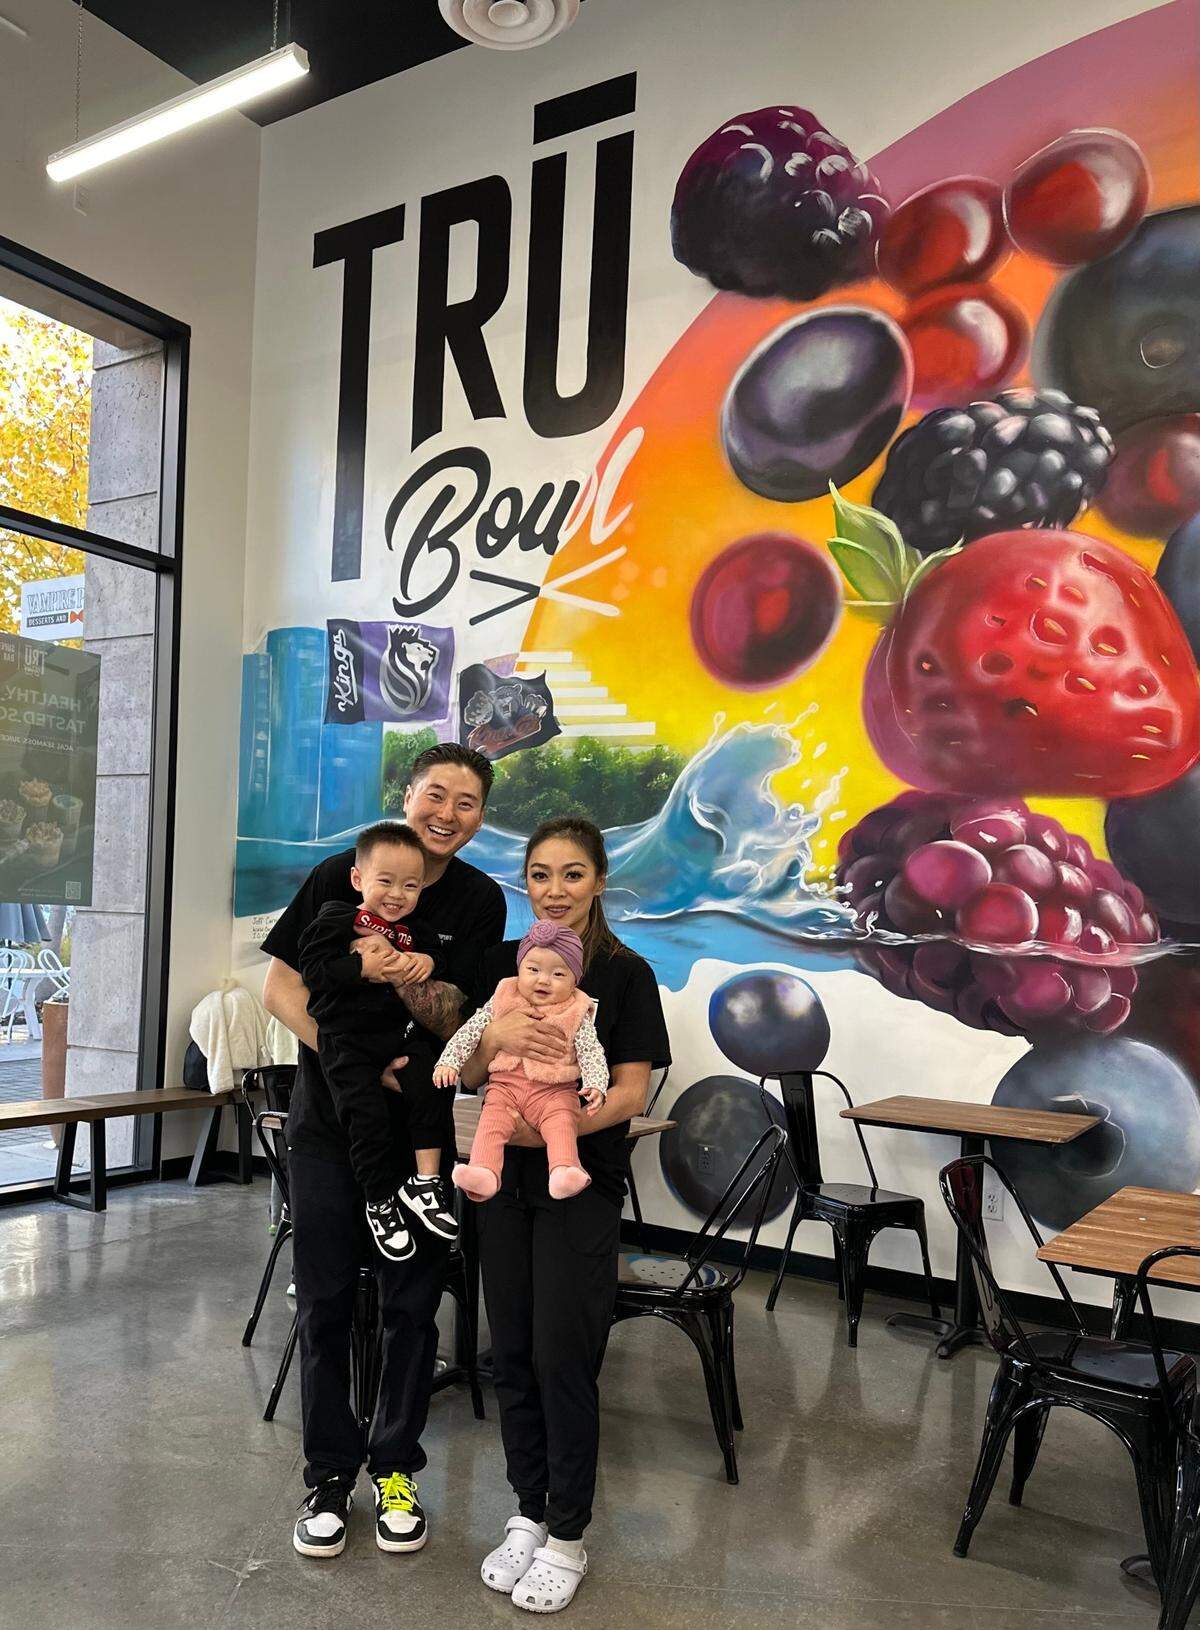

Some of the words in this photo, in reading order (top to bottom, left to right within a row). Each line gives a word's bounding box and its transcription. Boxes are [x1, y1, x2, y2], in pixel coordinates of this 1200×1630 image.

[385, 426, 645, 618] Bowl
[27, 588, 75, 615] VAMPIRE
[28, 615, 55, 626] DESSERTS
[56, 613, 67, 623] AND
[332, 627, 359, 713] Kings
